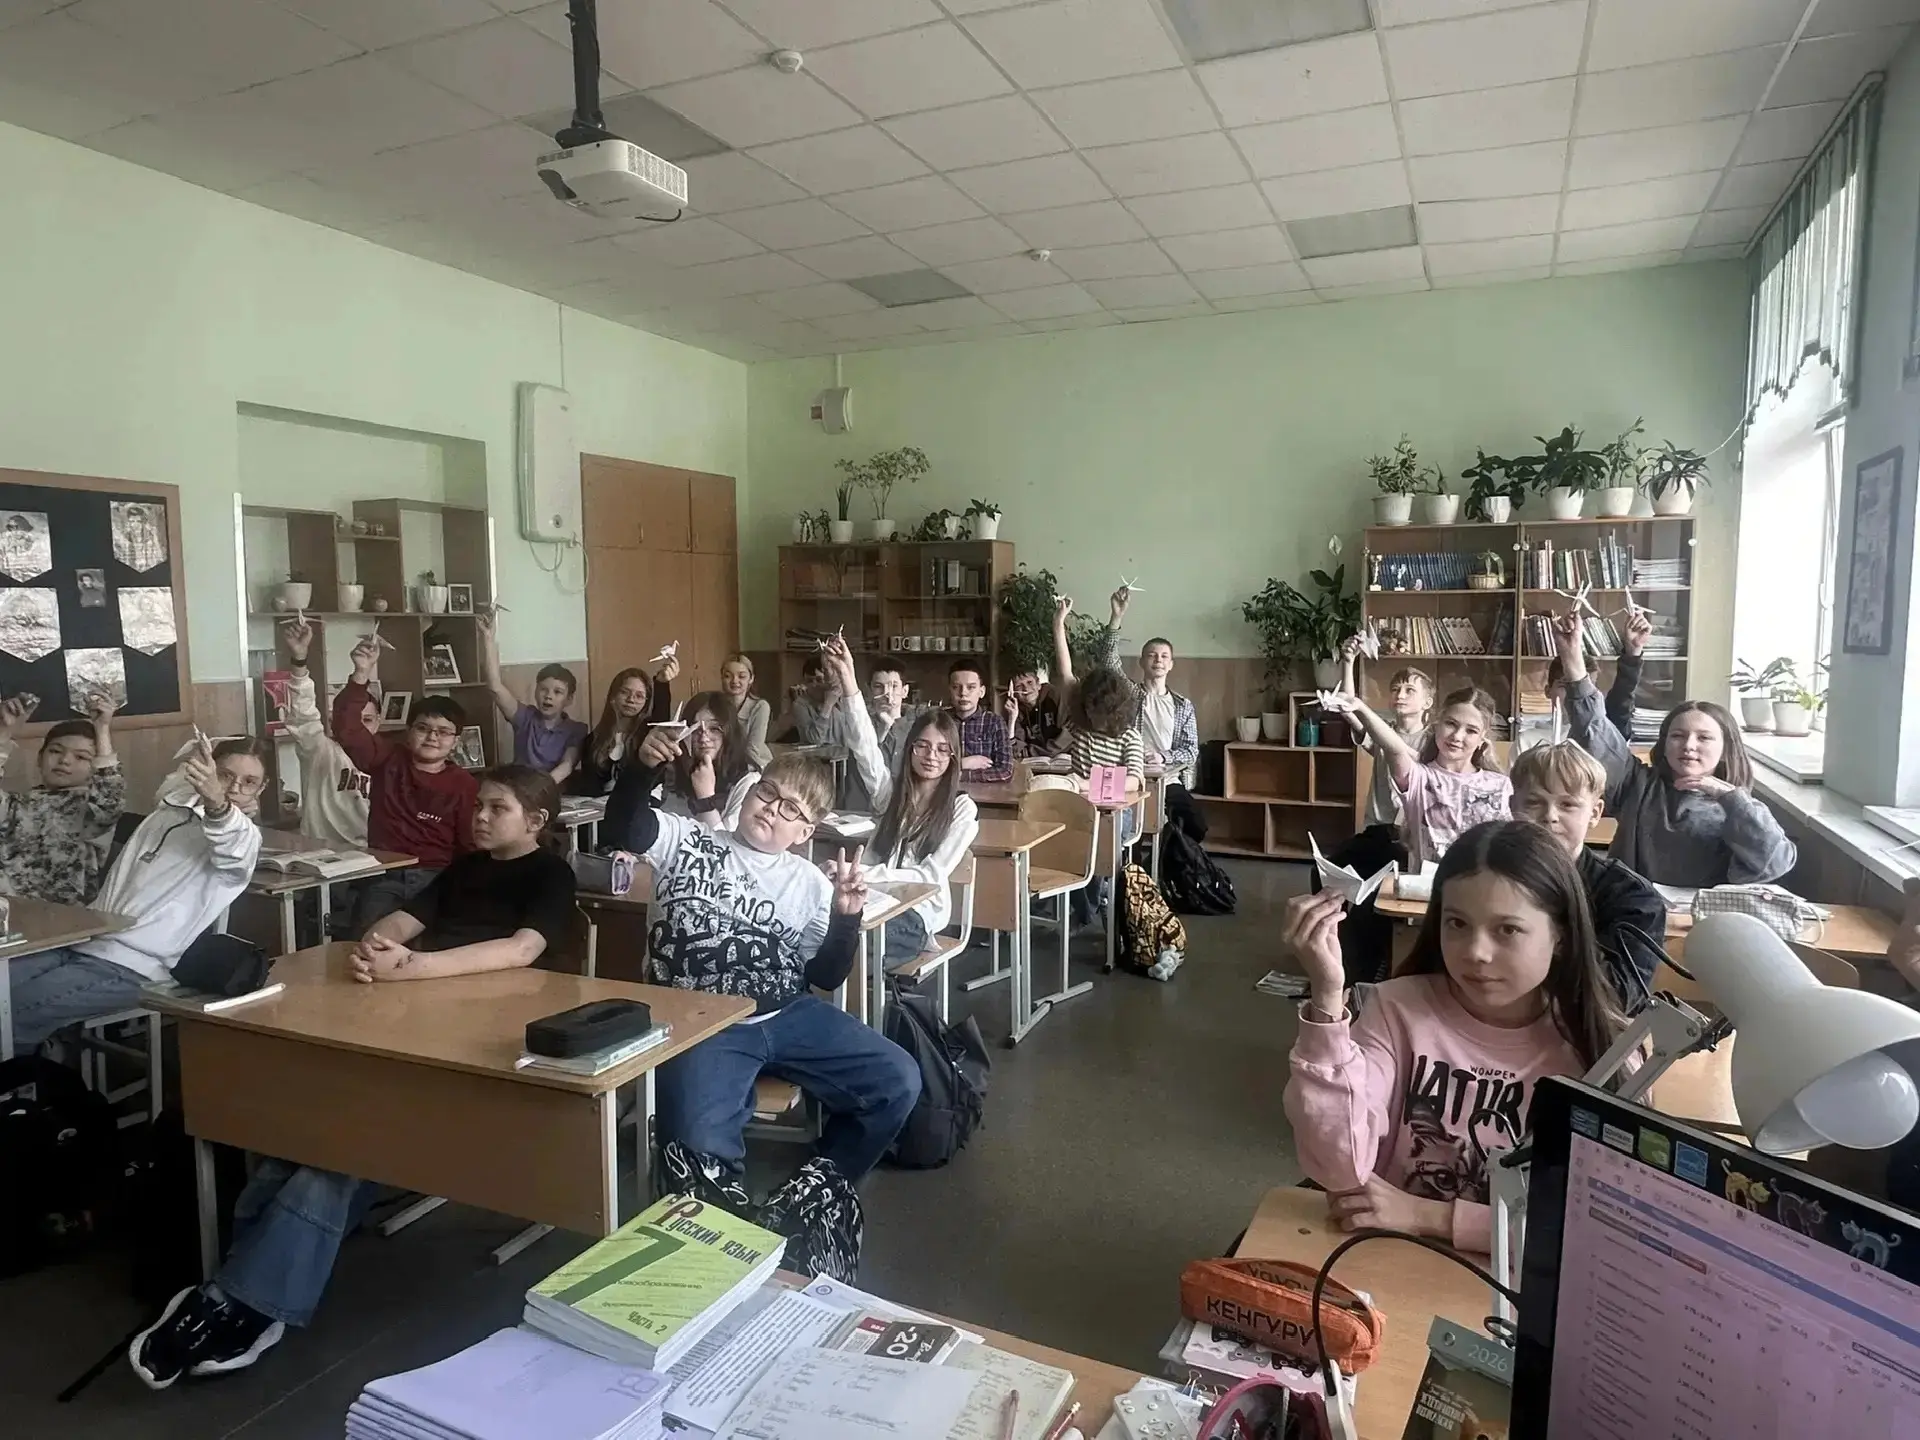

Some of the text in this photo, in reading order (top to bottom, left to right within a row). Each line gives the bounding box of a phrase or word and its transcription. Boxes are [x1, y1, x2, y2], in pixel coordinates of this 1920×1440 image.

[656, 874, 733, 901] CREATIVE
[1470, 1065, 1516, 1079] WONDER
[648, 1200, 725, 1246] Русский
[549, 1225, 688, 1307] 7
[654, 1324, 668, 1336] 2
[1206, 1295, 1317, 1348] КЕНГУРУ
[1467, 1343, 1508, 1372] 2026
